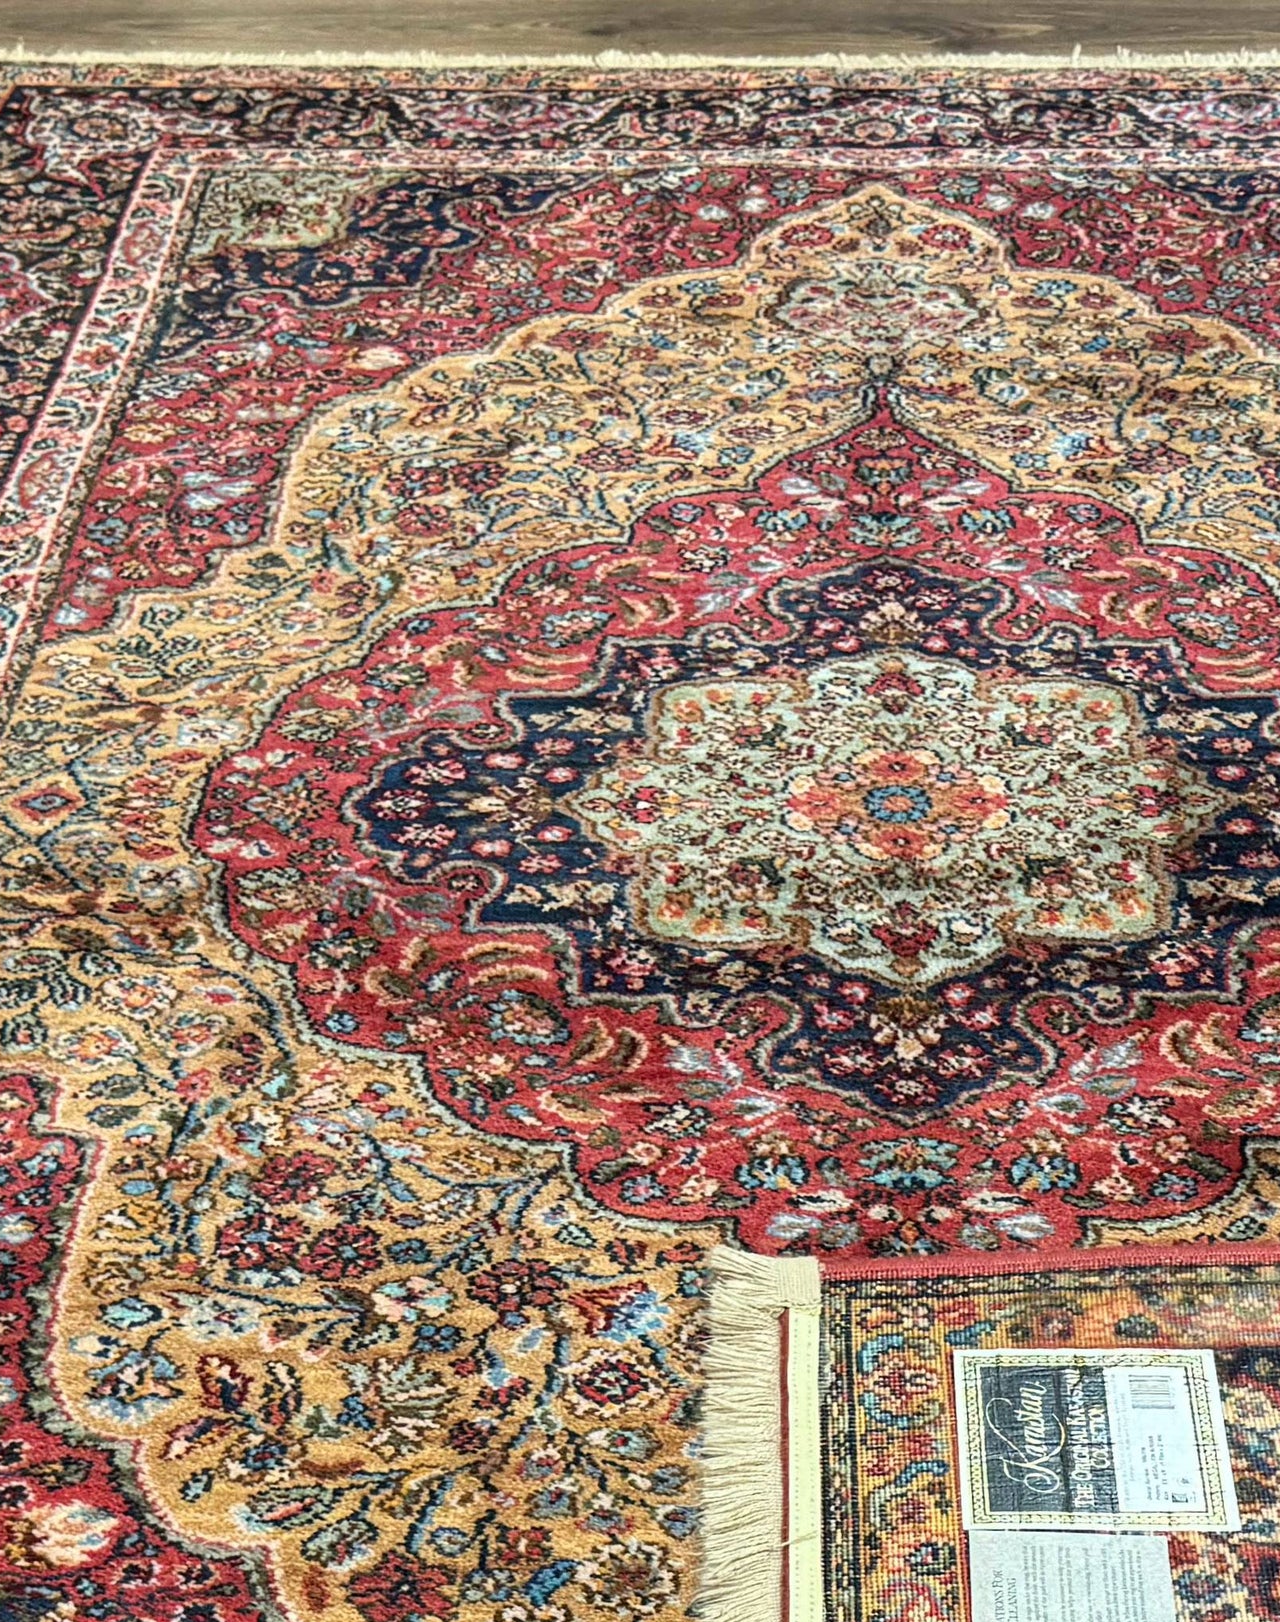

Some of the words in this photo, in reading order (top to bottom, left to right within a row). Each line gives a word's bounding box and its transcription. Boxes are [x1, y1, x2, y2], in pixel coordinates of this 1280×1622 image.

[986, 1381, 1066, 1492] Karastan
[1070, 1428, 1092, 1480] ORIGINAL
[1073, 1484, 1095, 1507] THE
[991, 1570, 1004, 1588] FOR
